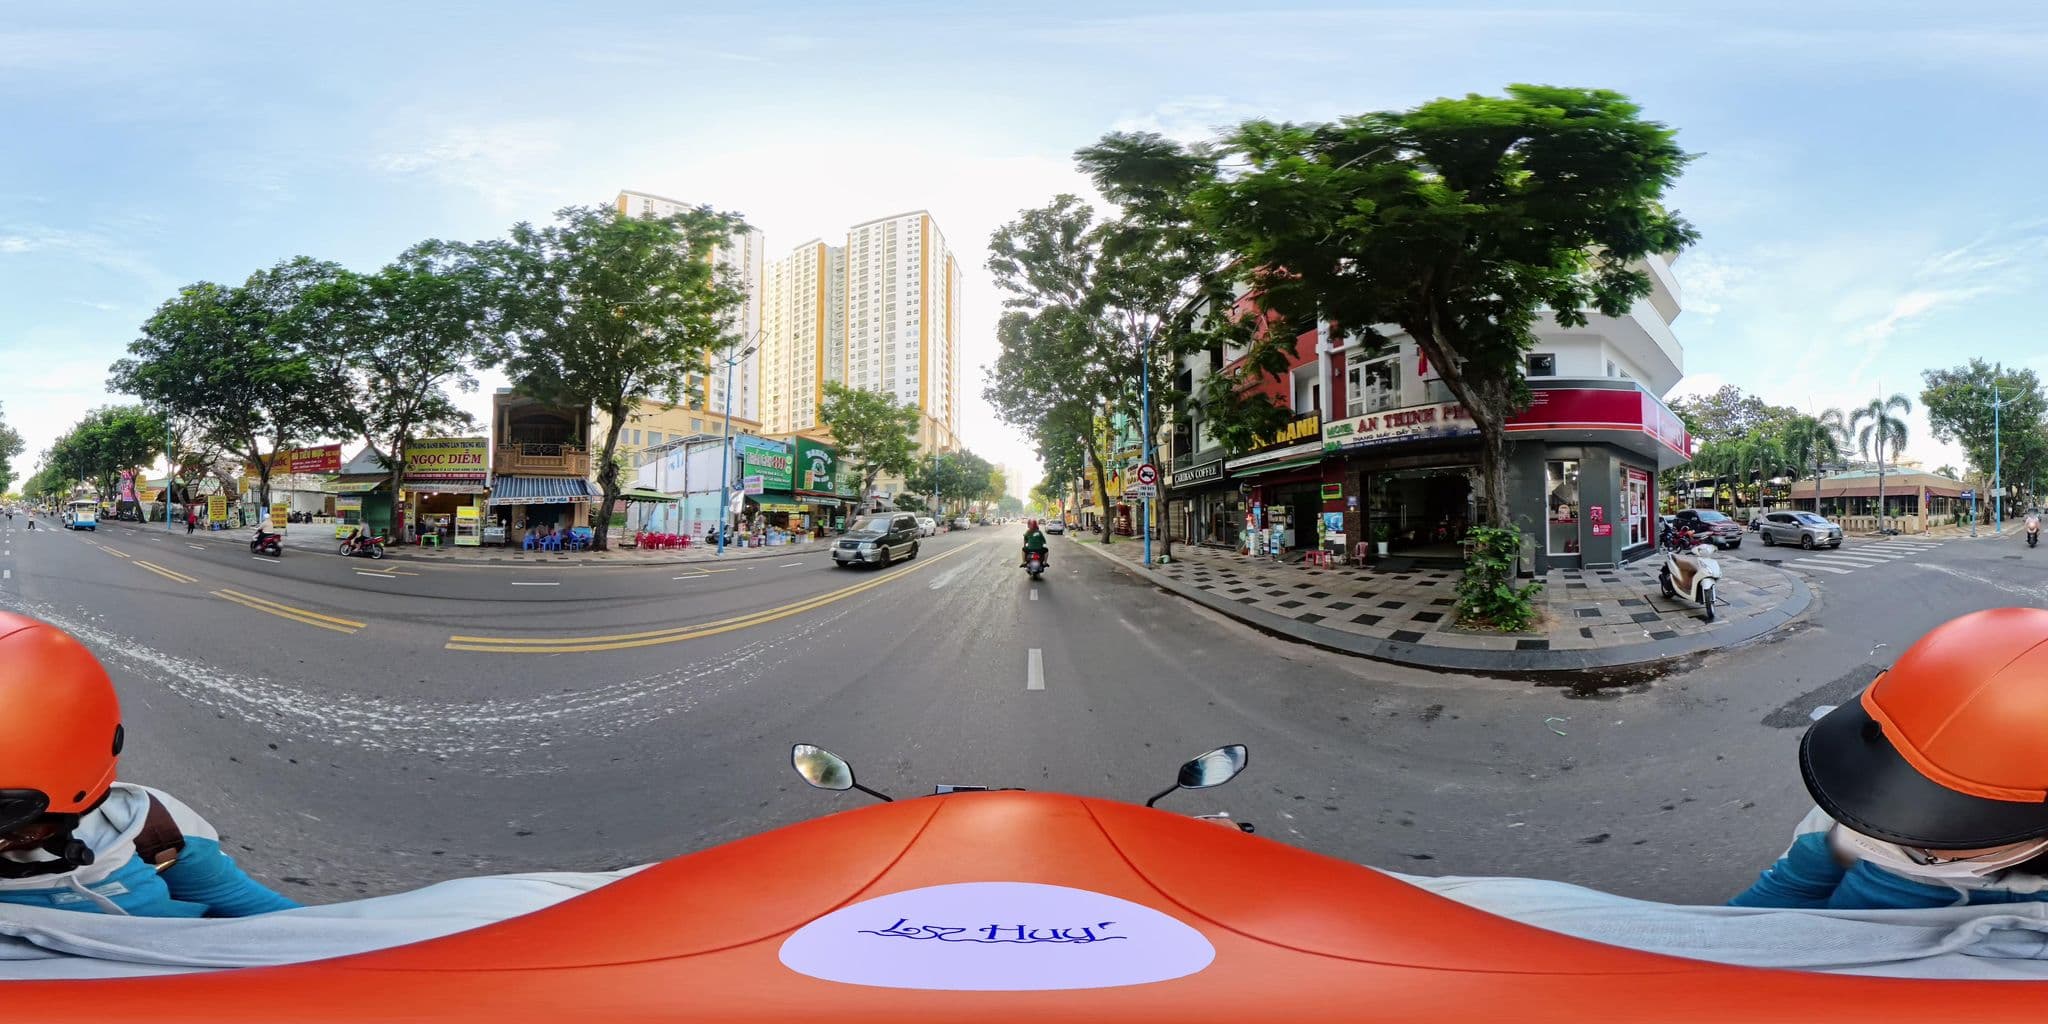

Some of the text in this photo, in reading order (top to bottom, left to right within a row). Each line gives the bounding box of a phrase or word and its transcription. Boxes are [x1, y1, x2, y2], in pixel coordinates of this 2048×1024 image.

[1358, 416, 1379, 433] AN
[1383, 408, 1436, 428] THỊNH
[411, 454, 445, 466] NGỌC
[1195, 466, 1217, 479] COFFEE
